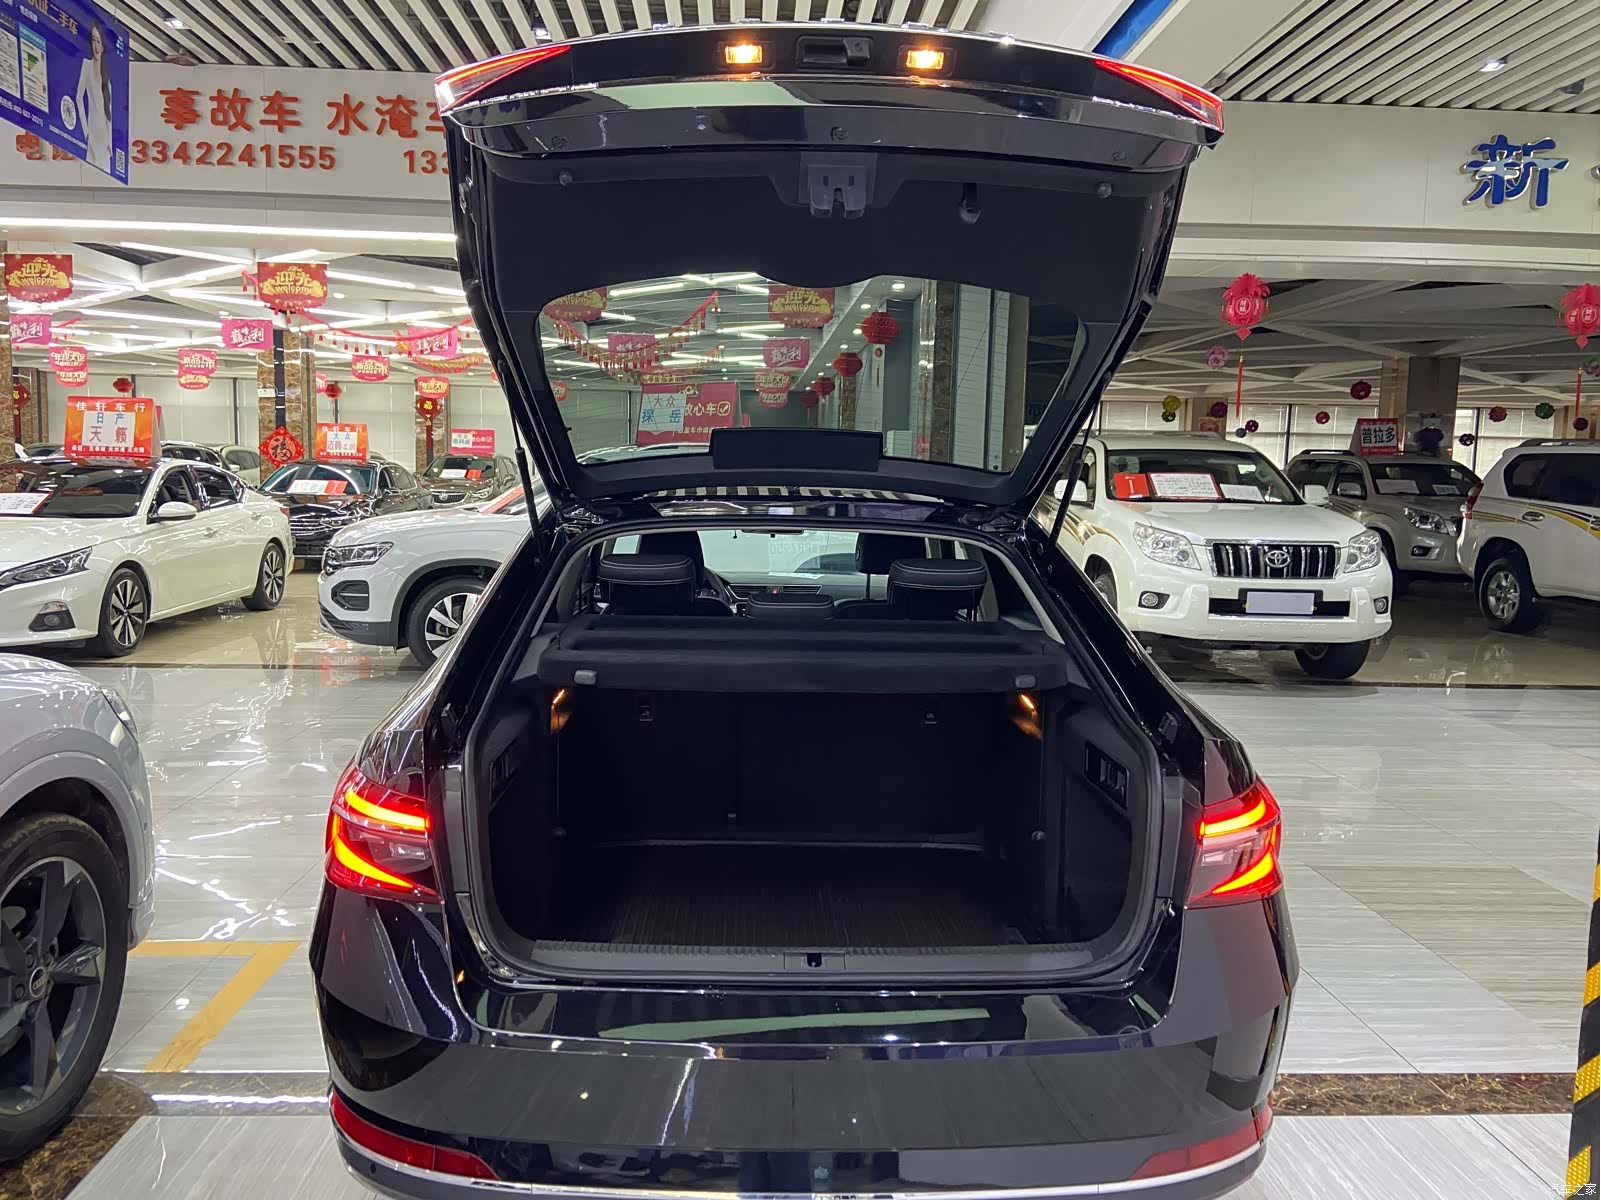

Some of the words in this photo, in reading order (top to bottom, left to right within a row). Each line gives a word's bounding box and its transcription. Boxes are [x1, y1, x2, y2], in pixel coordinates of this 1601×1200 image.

[159, 87, 302, 133] 事故车
[131, 139, 336, 170] 3342241555
[1463, 134, 1570, 208] 新
[75, 401, 147, 413] 佳轩车行
[653, 395, 676, 408] 大众
[96, 411, 125, 425] 日产
[641, 408, 682, 424] 探岳
[88, 425, 128, 444] 天籁
[1361, 426, 1396, 444] 普拉多
[271, 437, 293, 461] 福
